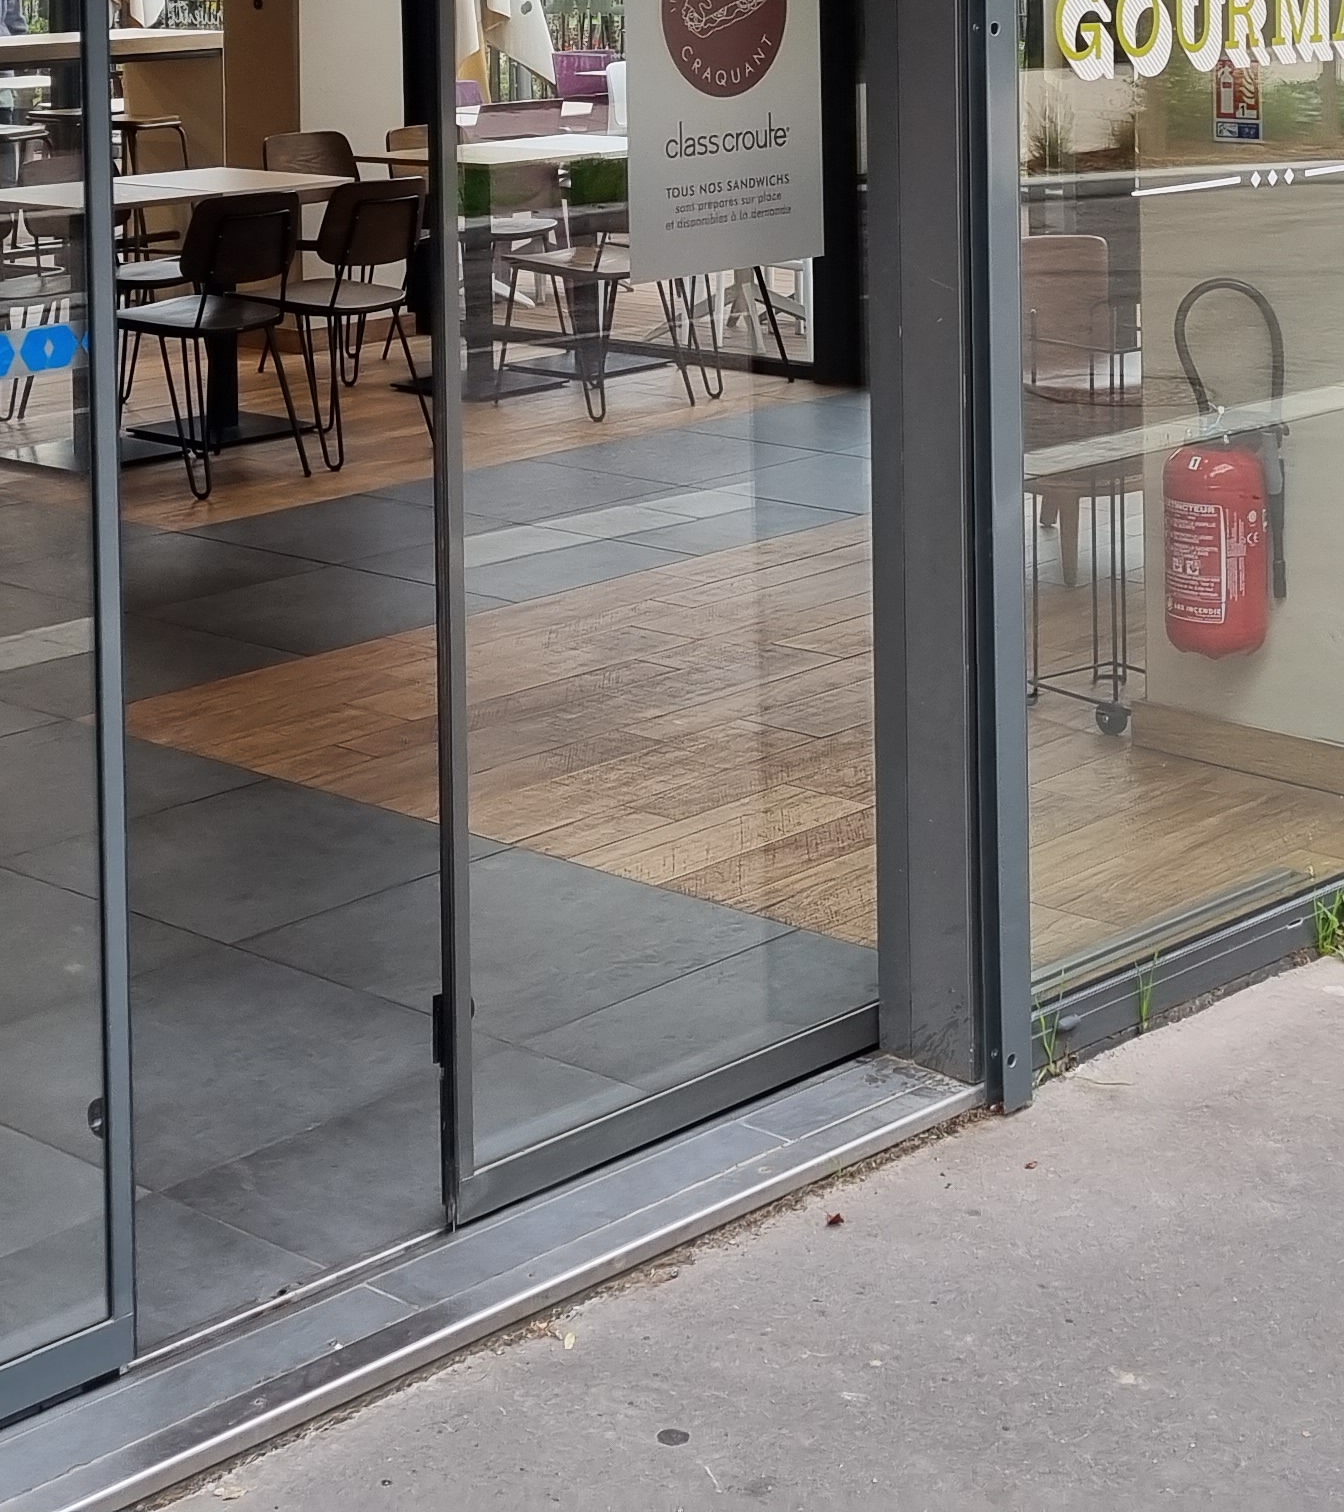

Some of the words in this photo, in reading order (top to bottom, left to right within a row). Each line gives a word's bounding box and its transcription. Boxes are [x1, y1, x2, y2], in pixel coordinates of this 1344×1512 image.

[681, 34, 773, 86] CRAQUANT
[666, 121, 719, 159] class
[666, 185, 695, 199] TOUS
[699, 182, 723, 195] NOS
[727, 173, 790, 191] SANDWICHS
